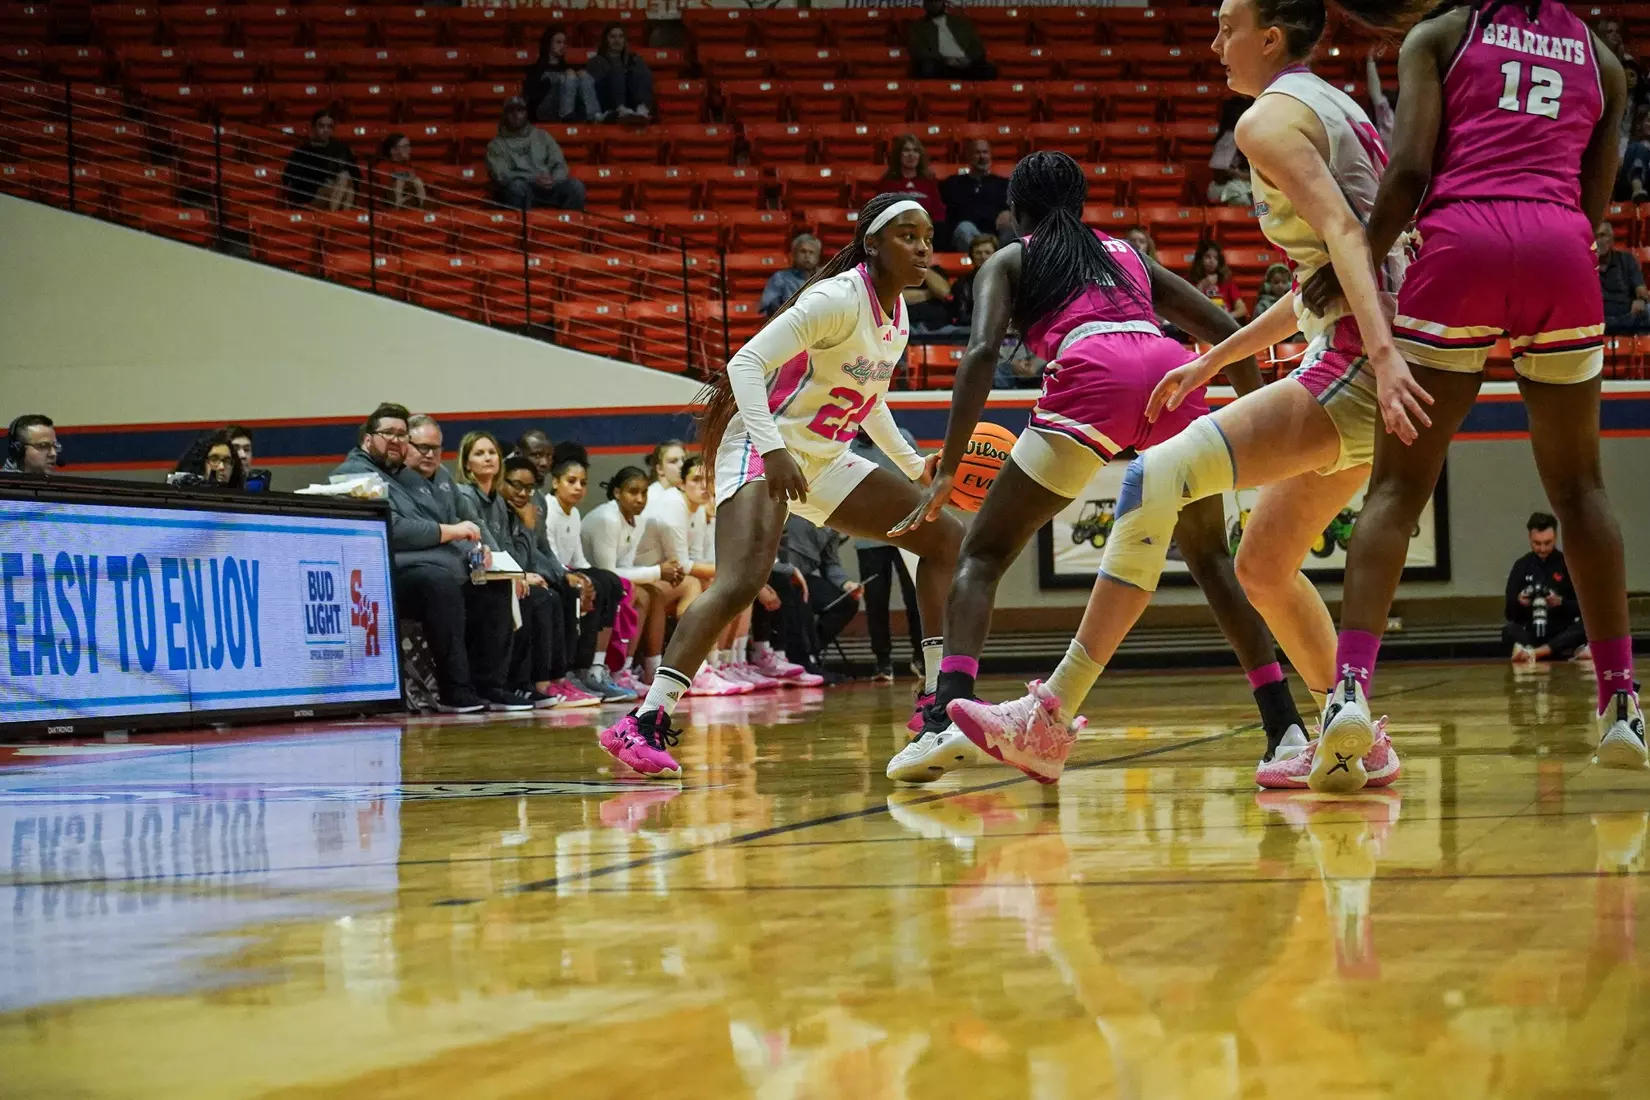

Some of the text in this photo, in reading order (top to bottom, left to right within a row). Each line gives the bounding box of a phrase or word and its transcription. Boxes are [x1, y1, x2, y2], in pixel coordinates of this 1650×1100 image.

[1482, 23, 1585, 66] BEARKATS
[1497, 60, 1563, 120] 12
[963, 440, 1009, 460] ilso
[307, 570, 334, 602] BUD
[2, 550, 262, 676] EASY TO ENJOY
[305, 603, 342, 635] LIGHT
